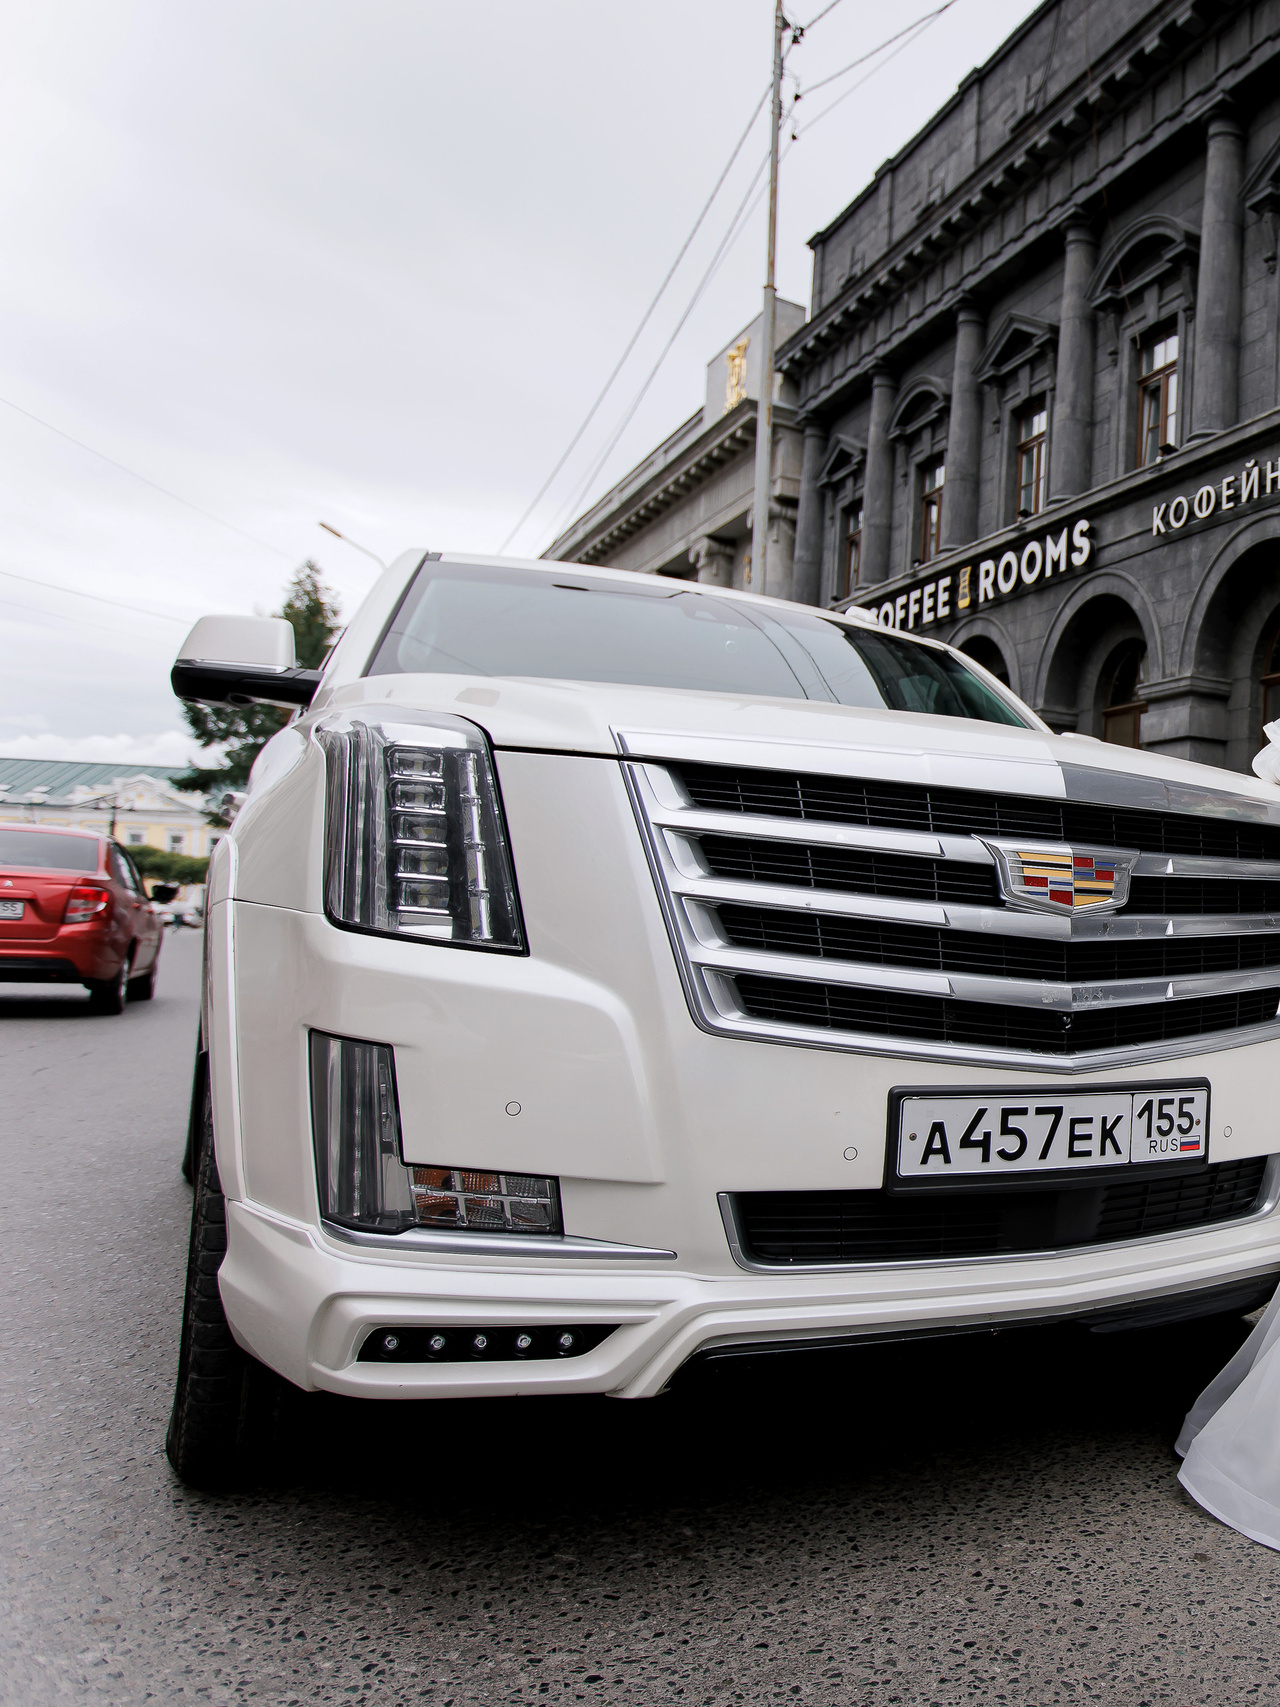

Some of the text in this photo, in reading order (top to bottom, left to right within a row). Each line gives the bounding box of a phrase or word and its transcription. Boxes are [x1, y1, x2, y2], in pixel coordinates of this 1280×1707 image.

[870, 519, 1091, 630] OFFEE ROOMS
[1136, 1097, 1196, 1138] 155
[1149, 1138, 1178, 1154] RUS
